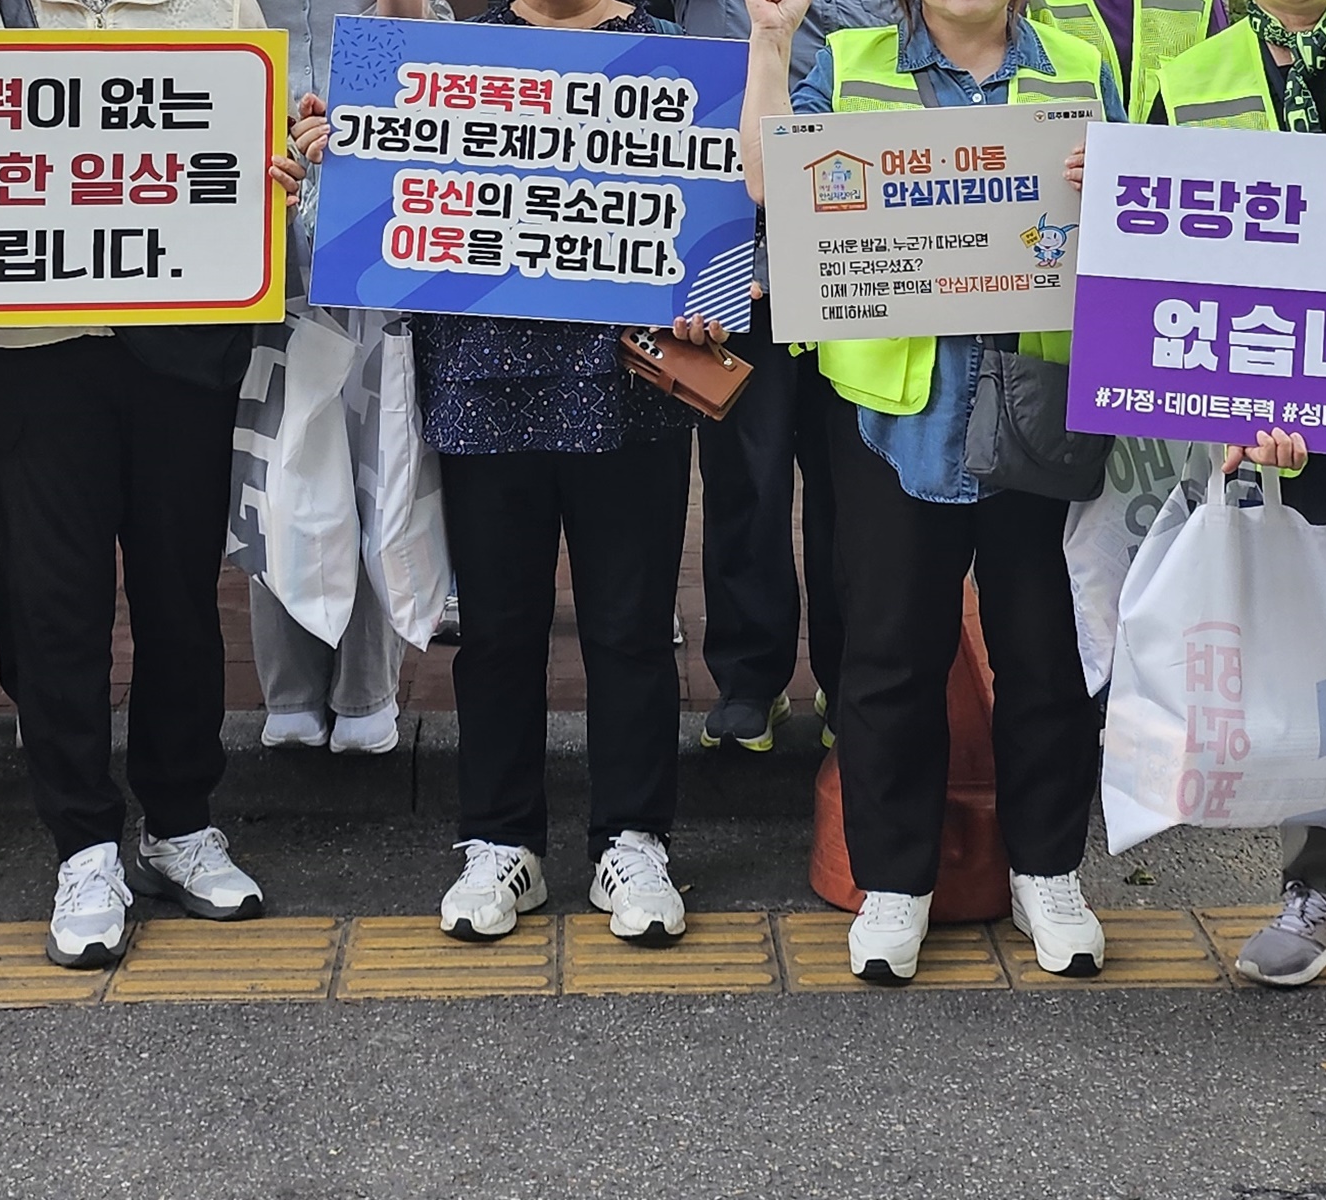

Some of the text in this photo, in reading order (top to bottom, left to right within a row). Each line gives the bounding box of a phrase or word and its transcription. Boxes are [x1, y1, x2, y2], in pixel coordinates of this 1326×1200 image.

[101, 77, 213, 131] 없는
[403, 71, 689, 124] 가정폭력 더 이상
[336, 113, 744, 174] 가정의 문제가 아닙니다.
[881, 146, 1007, 176] 여성 아동
[70, 151, 241, 206] 일상을
[401, 177, 676, 230] 당신의 목소리가
[882, 175, 1040, 209] 안심지킴이집
[1115, 174, 1307, 244] 정당한
[391, 225, 677, 278] 이웃을 구합니다.
[818, 233, 989, 255] 무서운 밤길, 누군가 따라오면
[820, 258, 923, 277] 많이 두려우셨죠?
[821, 282, 847, 298] 이제
[852, 281, 890, 297] 가까운
[893, 280, 932, 295] 편의점
[822, 304, 888, 321] 대피하세요
